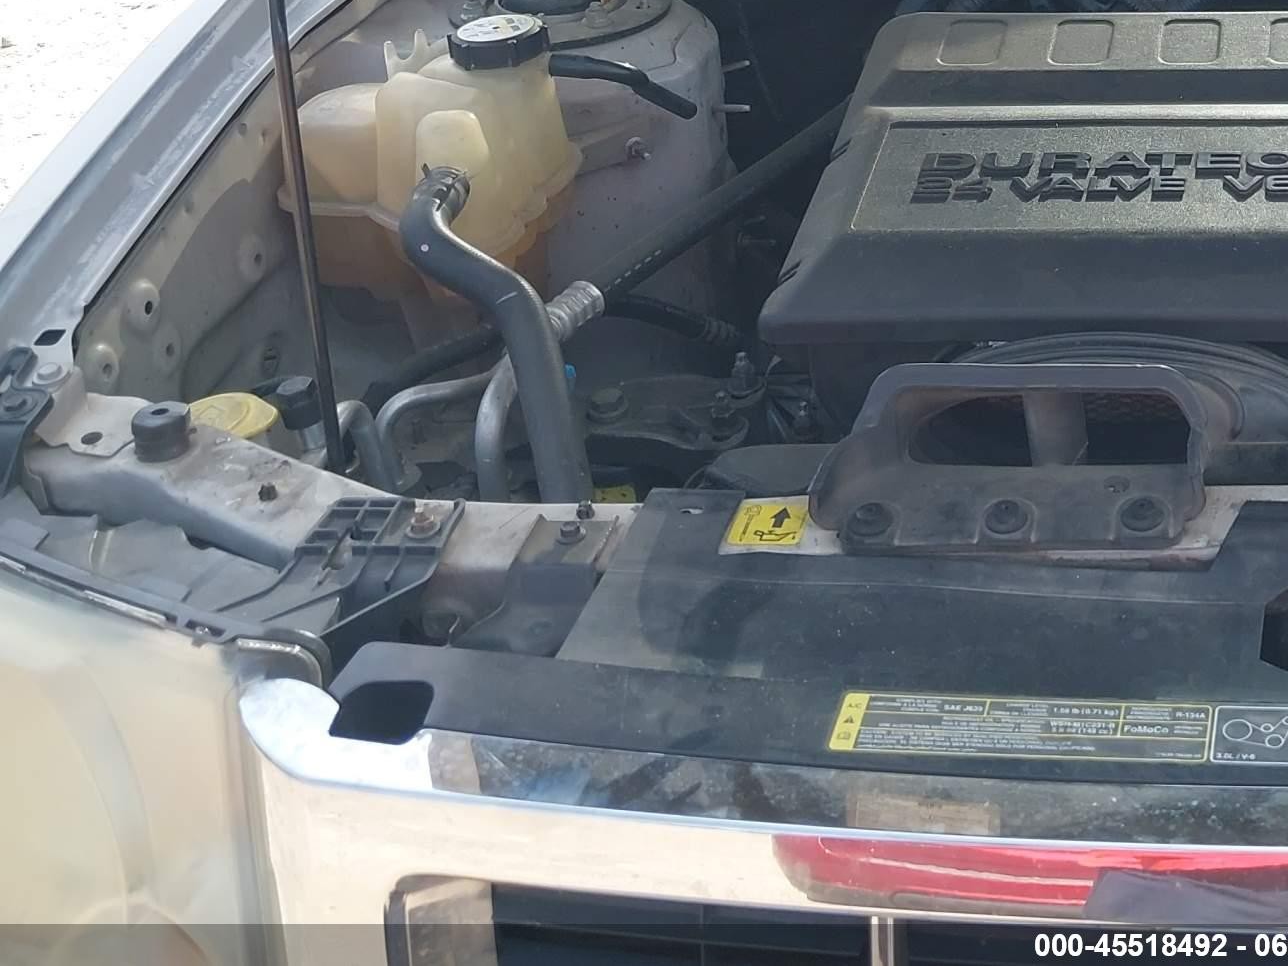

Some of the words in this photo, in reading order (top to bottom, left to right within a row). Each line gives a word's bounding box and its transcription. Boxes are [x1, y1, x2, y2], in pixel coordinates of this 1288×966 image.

[910, 176, 993, 204] 24
[1008, 175, 1186, 204] VALVE
[1123, 724, 1169, 734] FoMoCo
